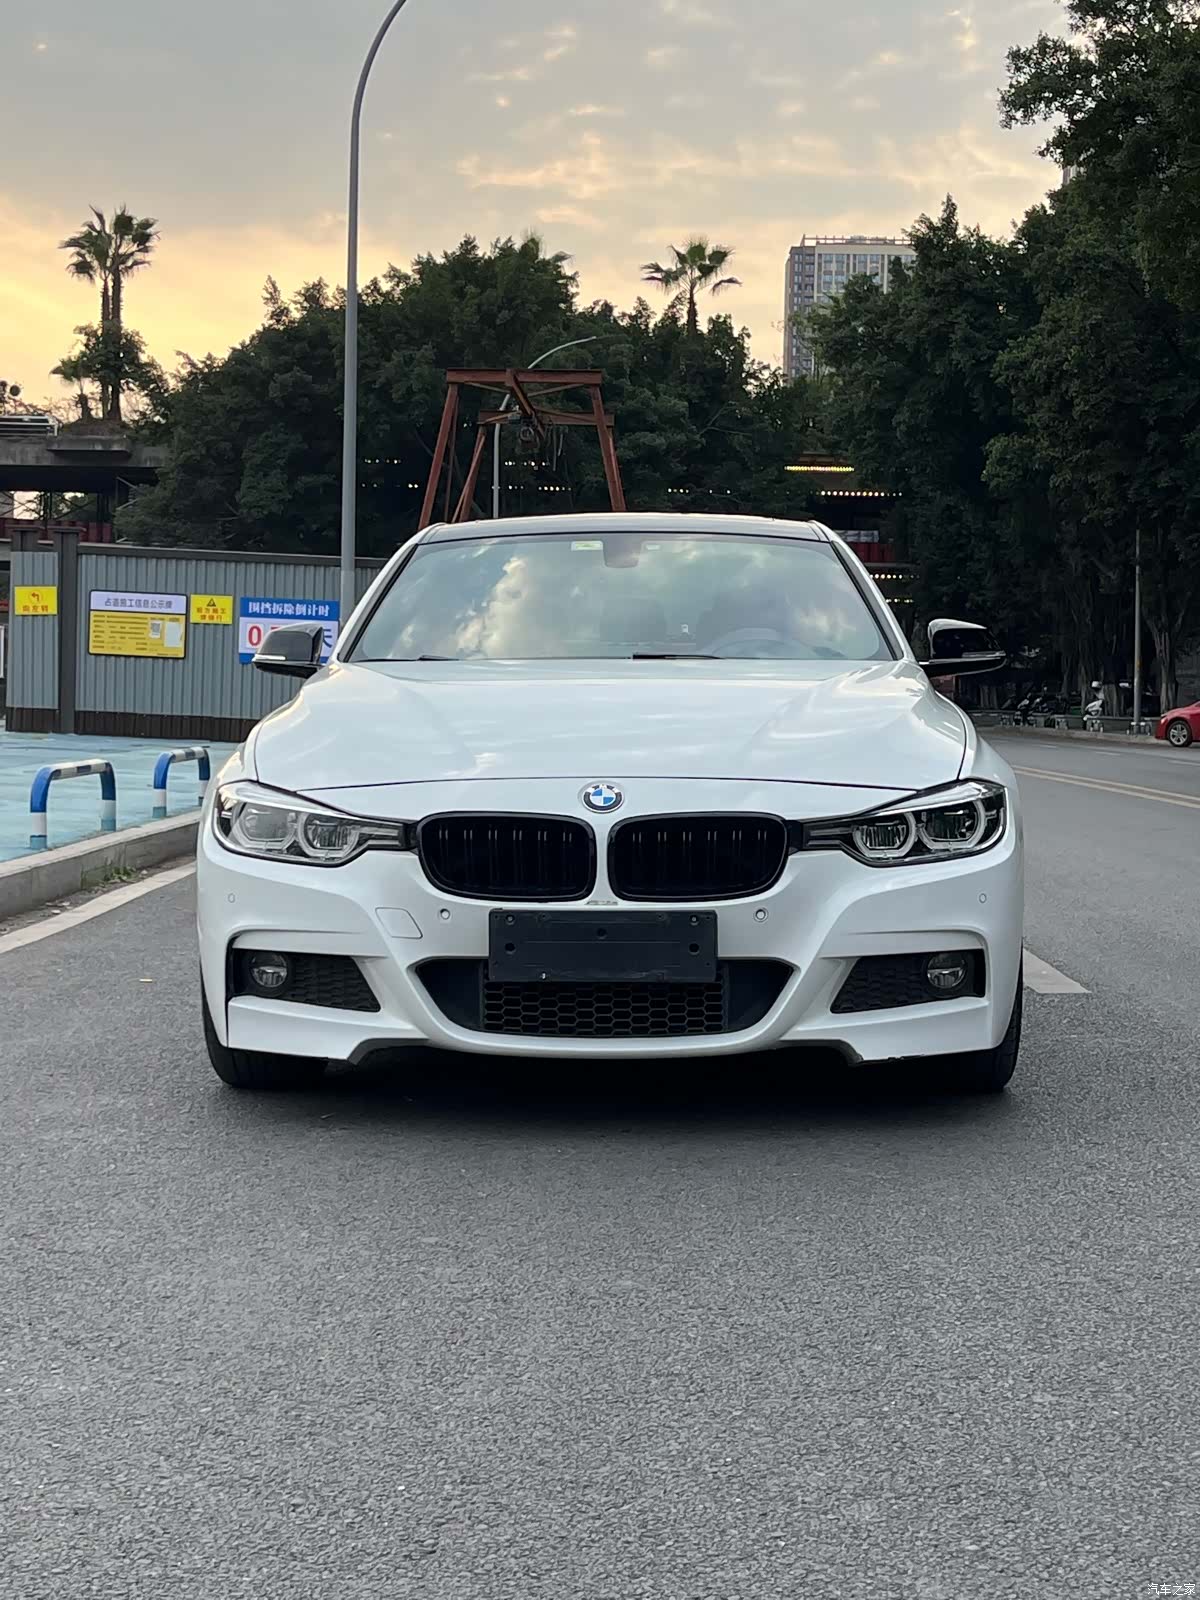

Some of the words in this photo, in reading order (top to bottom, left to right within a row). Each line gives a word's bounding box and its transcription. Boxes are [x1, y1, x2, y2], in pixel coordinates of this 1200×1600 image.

[248, 601, 330, 617] 围挡拆除倒计时
